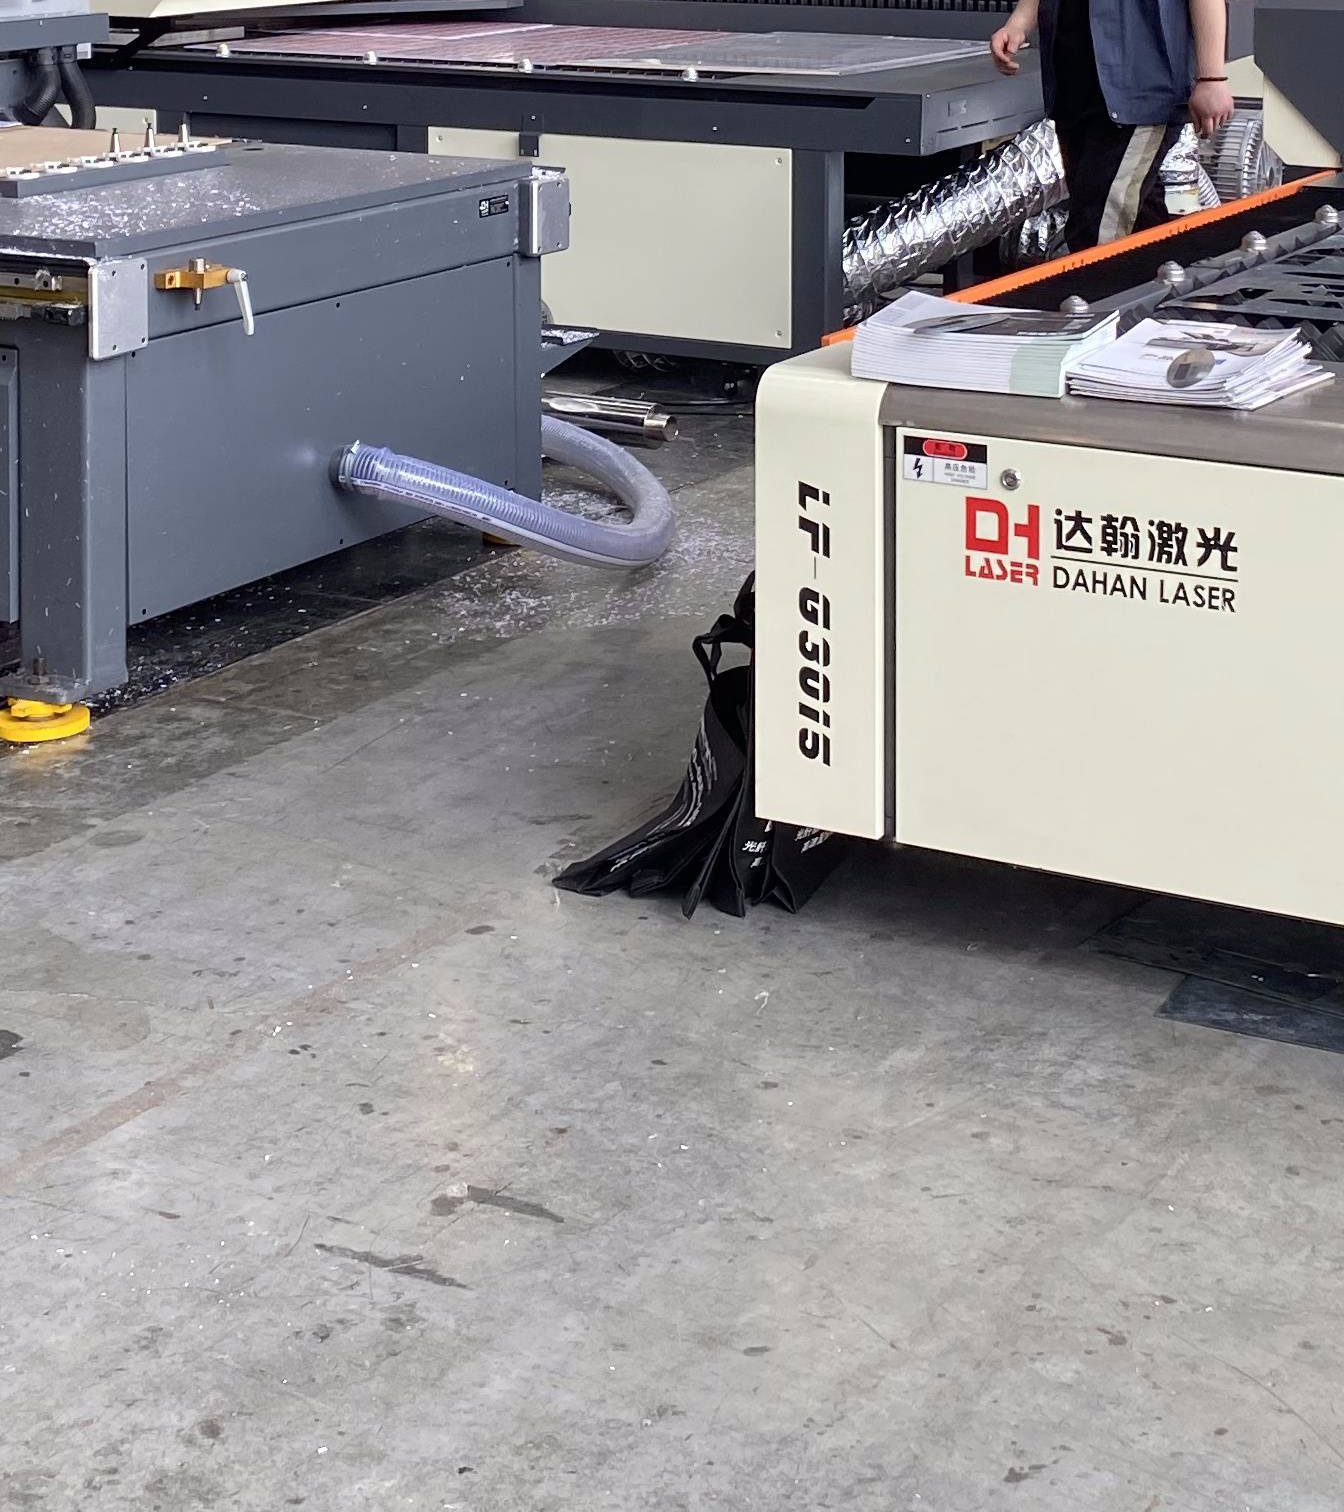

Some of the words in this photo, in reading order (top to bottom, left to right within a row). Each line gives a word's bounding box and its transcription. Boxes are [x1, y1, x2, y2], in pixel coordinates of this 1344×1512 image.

[965, 496, 1040, 561] DH
[1053, 508, 1239, 572] 达翰激光
[965, 555, 1041, 587] LASER
[1053, 566, 1147, 601] DAHAN
[1160, 579, 1237, 613] LASER
